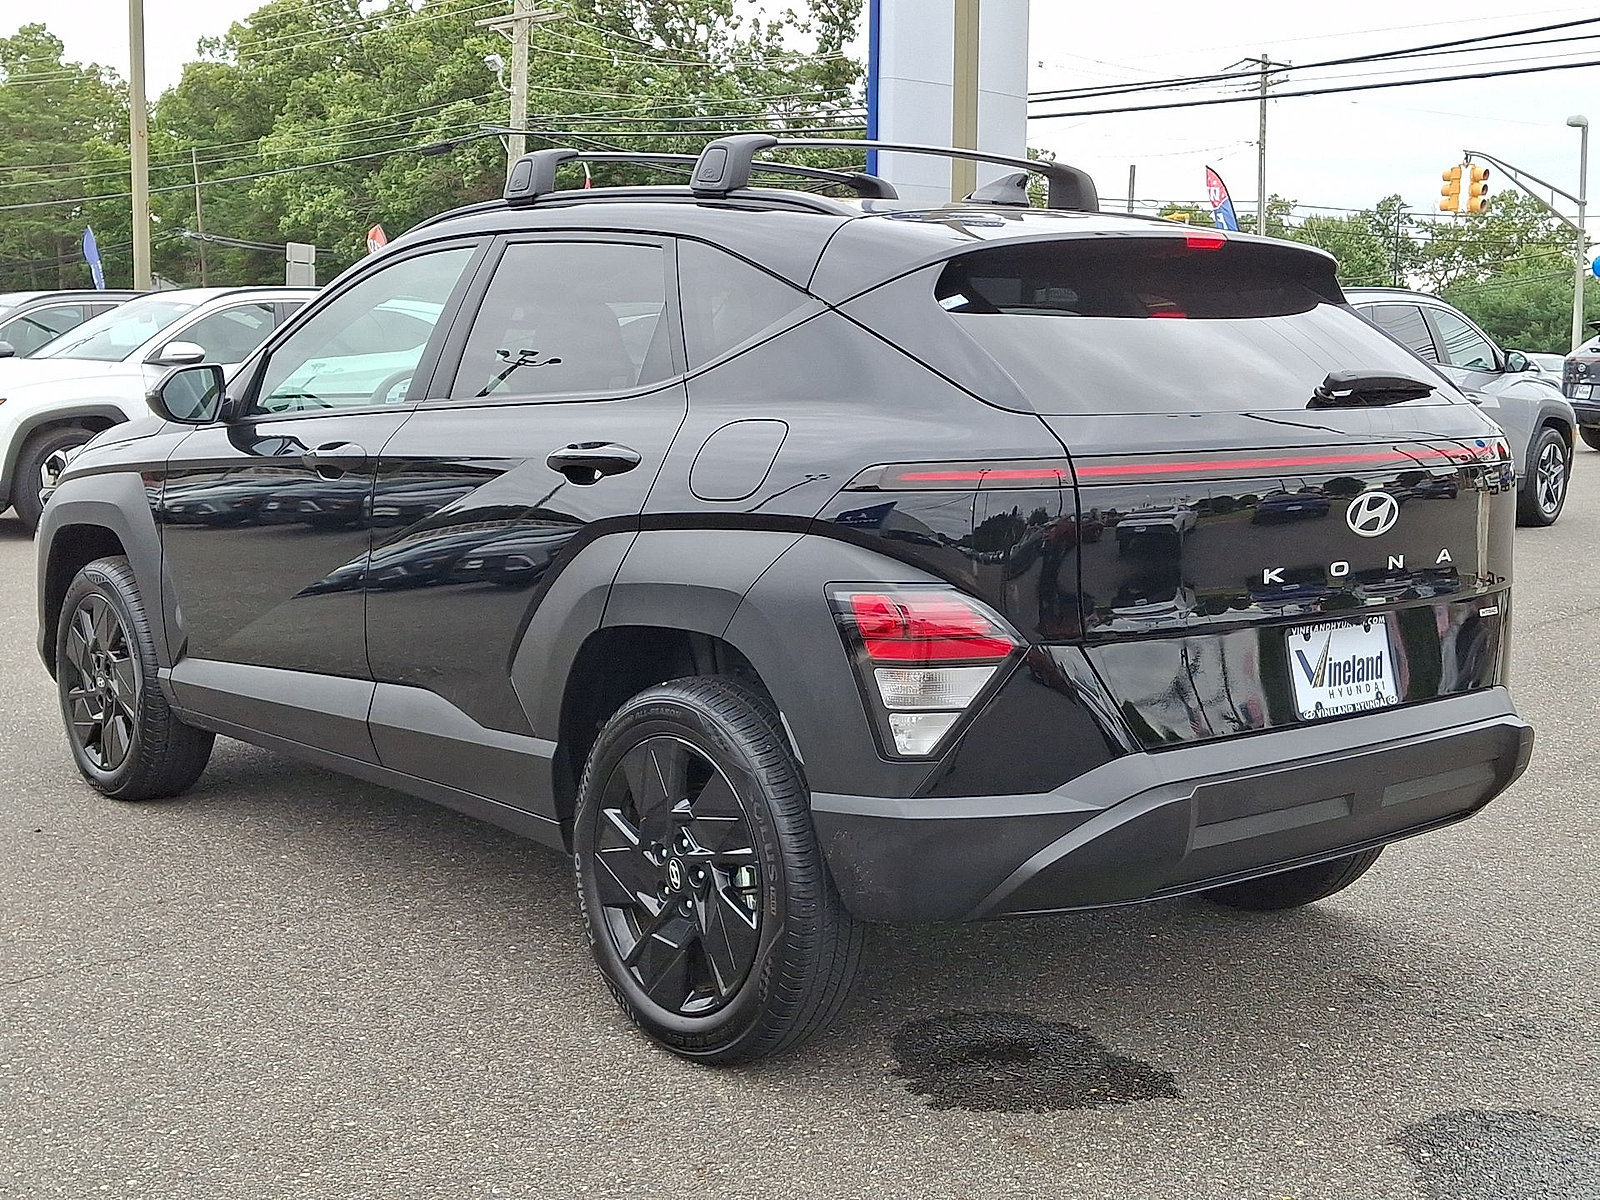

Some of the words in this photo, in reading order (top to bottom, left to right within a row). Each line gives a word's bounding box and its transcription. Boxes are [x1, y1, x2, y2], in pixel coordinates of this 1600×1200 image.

[1263, 548, 1453, 585] KONA
[1295, 631, 1383, 689] Vineland
[1328, 682, 1386, 699] HYUNDAI
[1316, 704, 1354, 718] VINELAND
[1355, 697, 1388, 714] HYUNDAI
